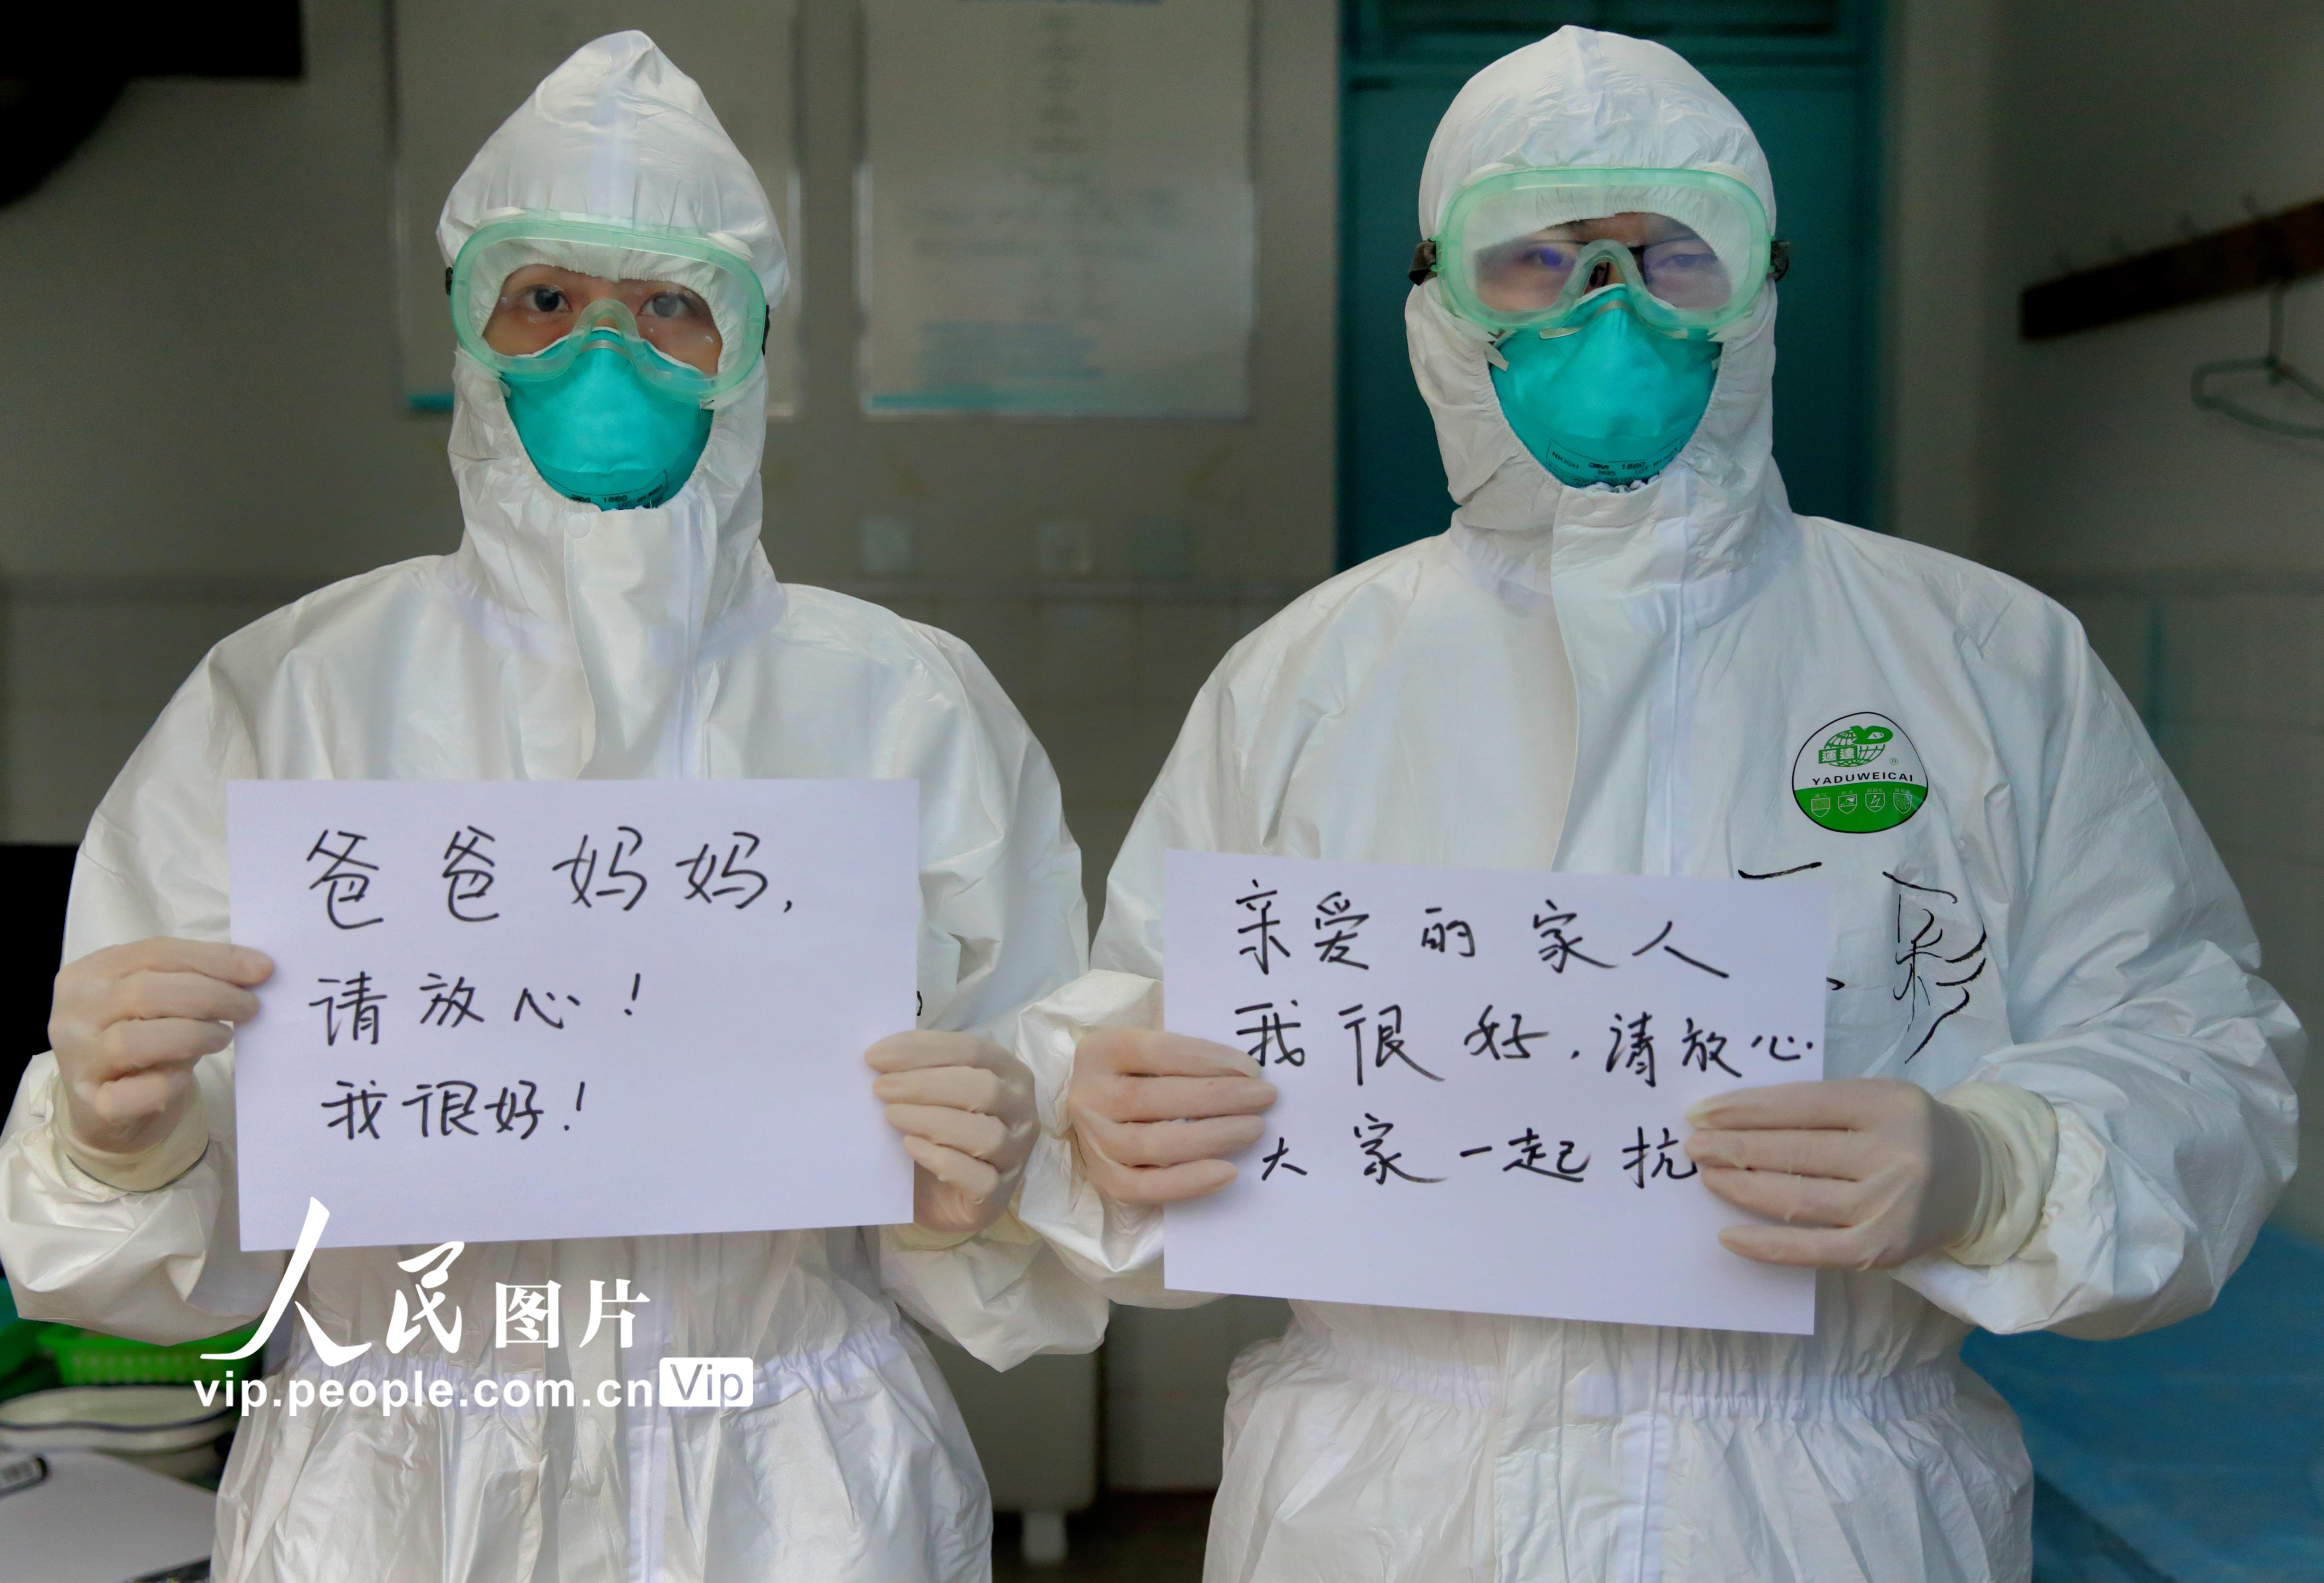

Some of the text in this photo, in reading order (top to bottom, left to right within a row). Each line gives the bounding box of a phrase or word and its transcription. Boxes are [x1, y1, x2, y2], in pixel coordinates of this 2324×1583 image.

[1621, 461, 1646, 470] 1860
[1813, 772, 1913, 786] YADUWEICAI
[1235, 879, 1730, 979] 亲爱的家人
